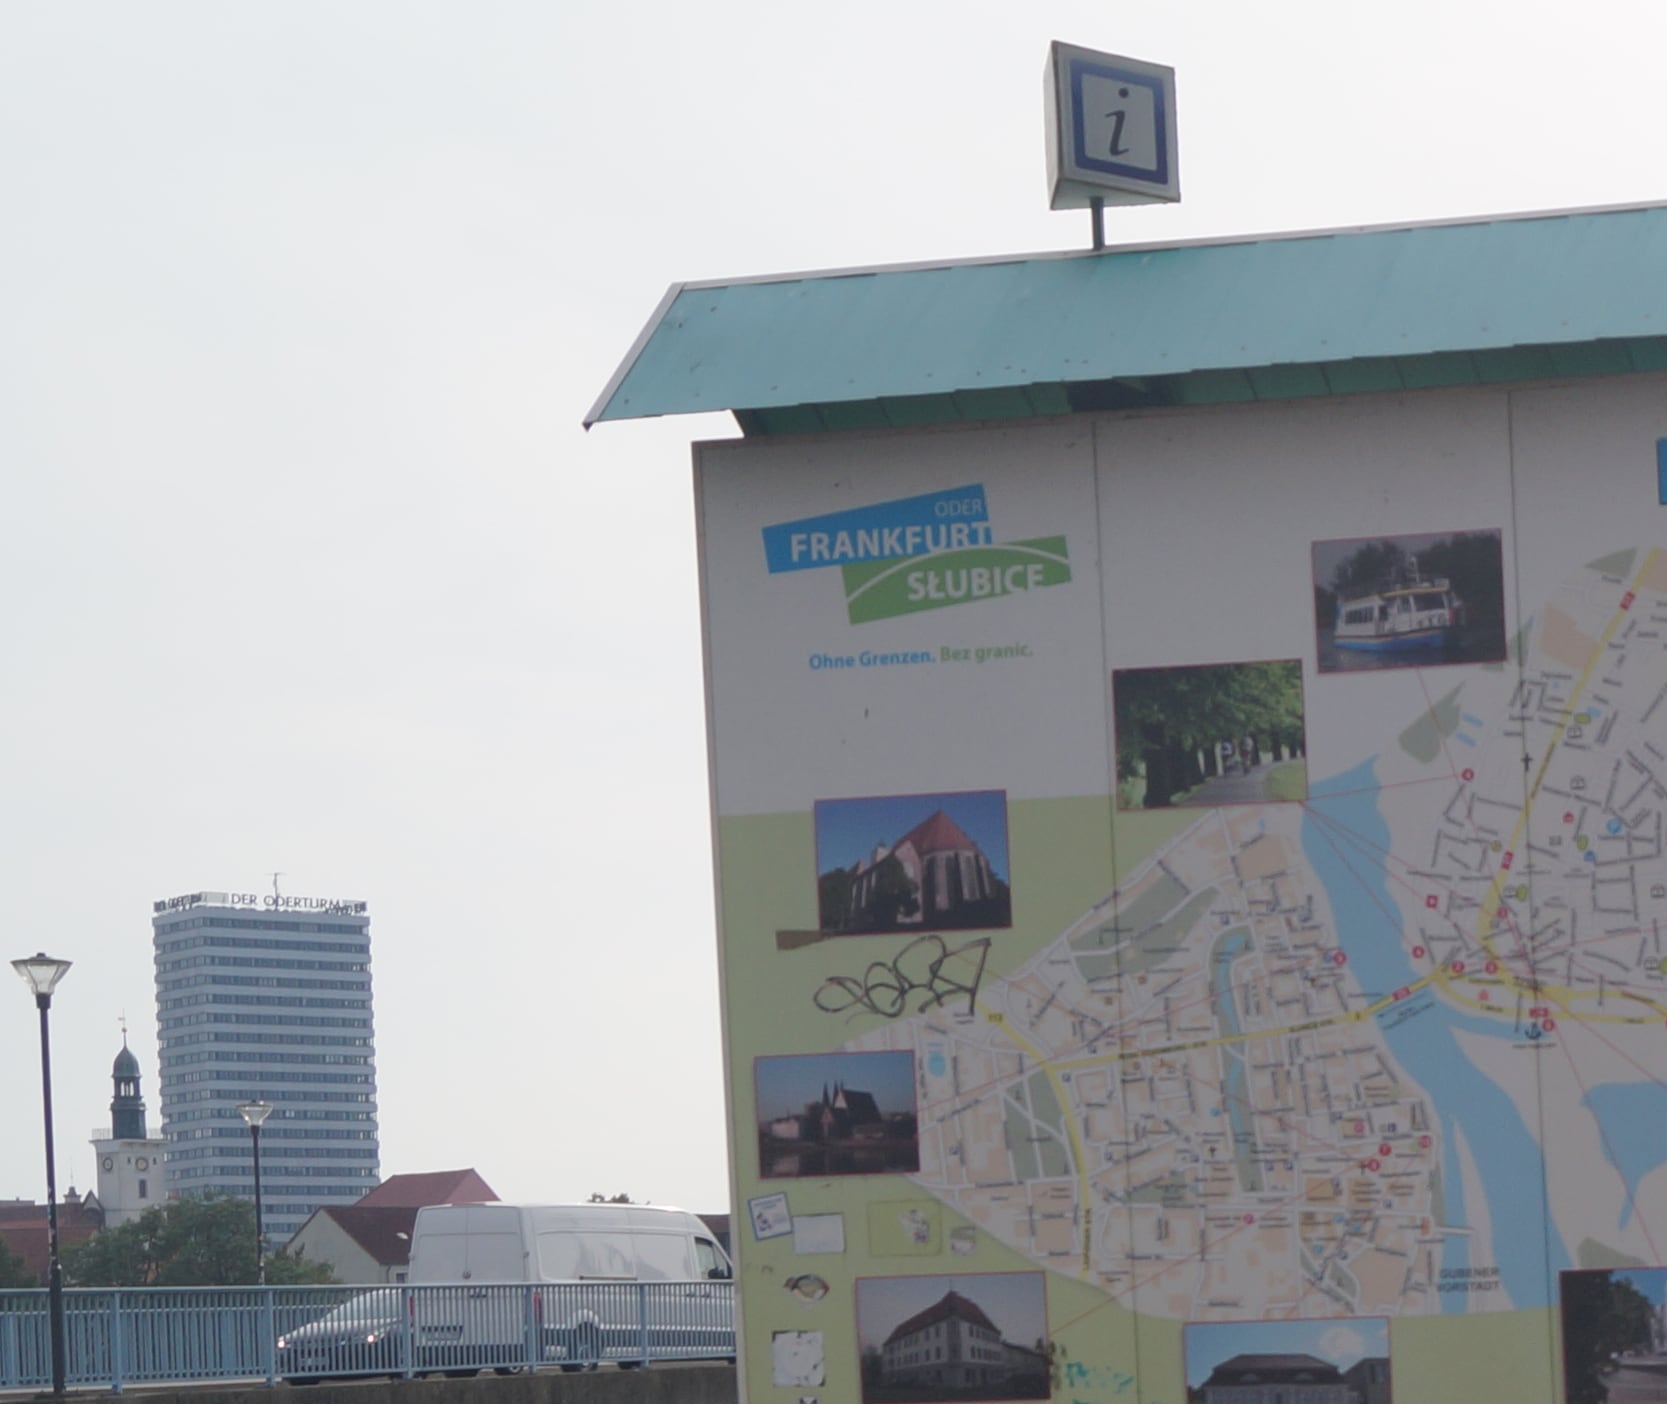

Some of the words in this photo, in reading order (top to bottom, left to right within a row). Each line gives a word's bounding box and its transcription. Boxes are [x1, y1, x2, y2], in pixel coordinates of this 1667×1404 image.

[1104, 87, 1130, 156] i
[934, 498, 983, 517] ODER
[790, 521, 992, 562] FRANKFURT
[907, 563, 1045, 601] SŁUBICE
[809, 653, 855, 670] Ohne
[859, 650, 936, 668] Grenzen.
[940, 646, 971, 662] Bez
[975, 642, 1033, 663] granic.
[231, 893, 258, 906] DER
[263, 895, 341, 910] ODERTURM
